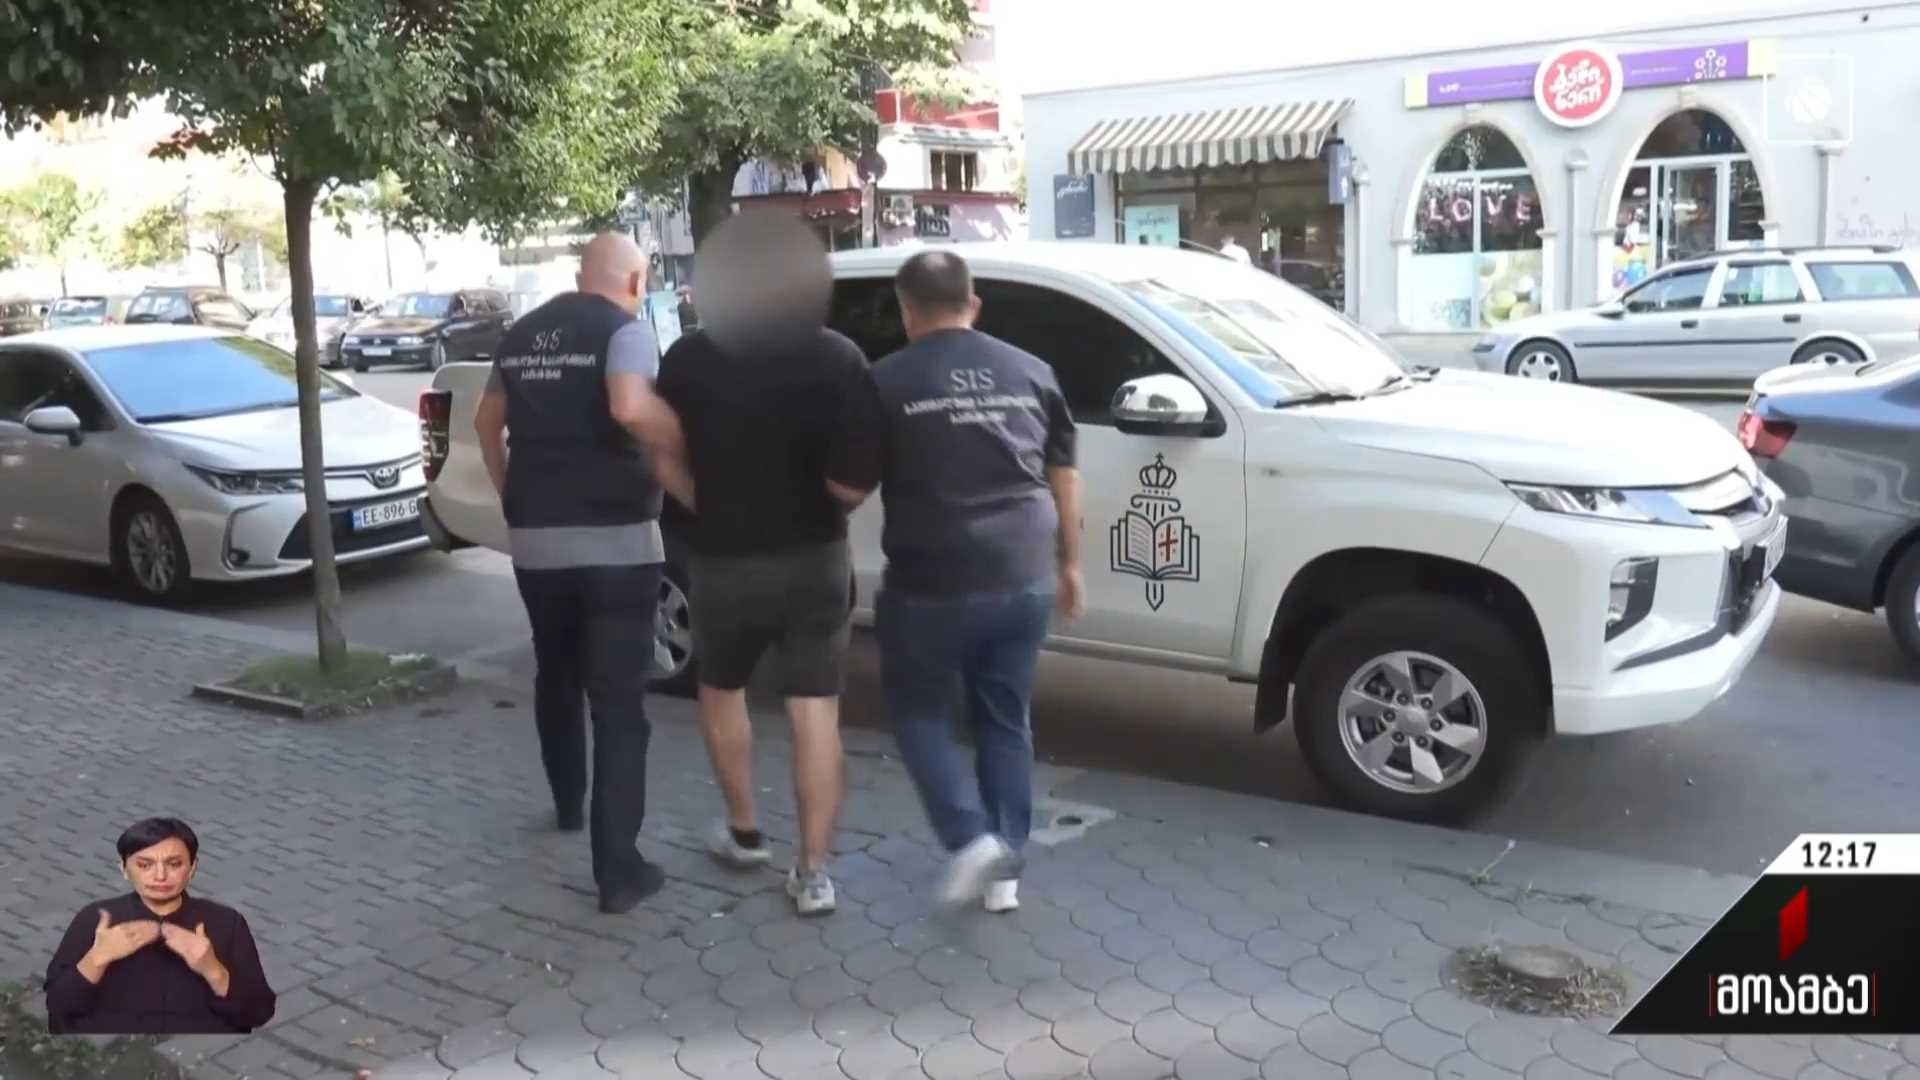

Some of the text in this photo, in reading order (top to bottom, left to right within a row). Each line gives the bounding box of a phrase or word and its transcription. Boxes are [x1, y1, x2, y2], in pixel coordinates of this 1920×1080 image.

[1427, 194, 1533, 223] LOVE
[532, 328, 563, 351] SIS
[950, 368, 996, 392] SIS
[362, 499, 419, 525] EE-896-G
